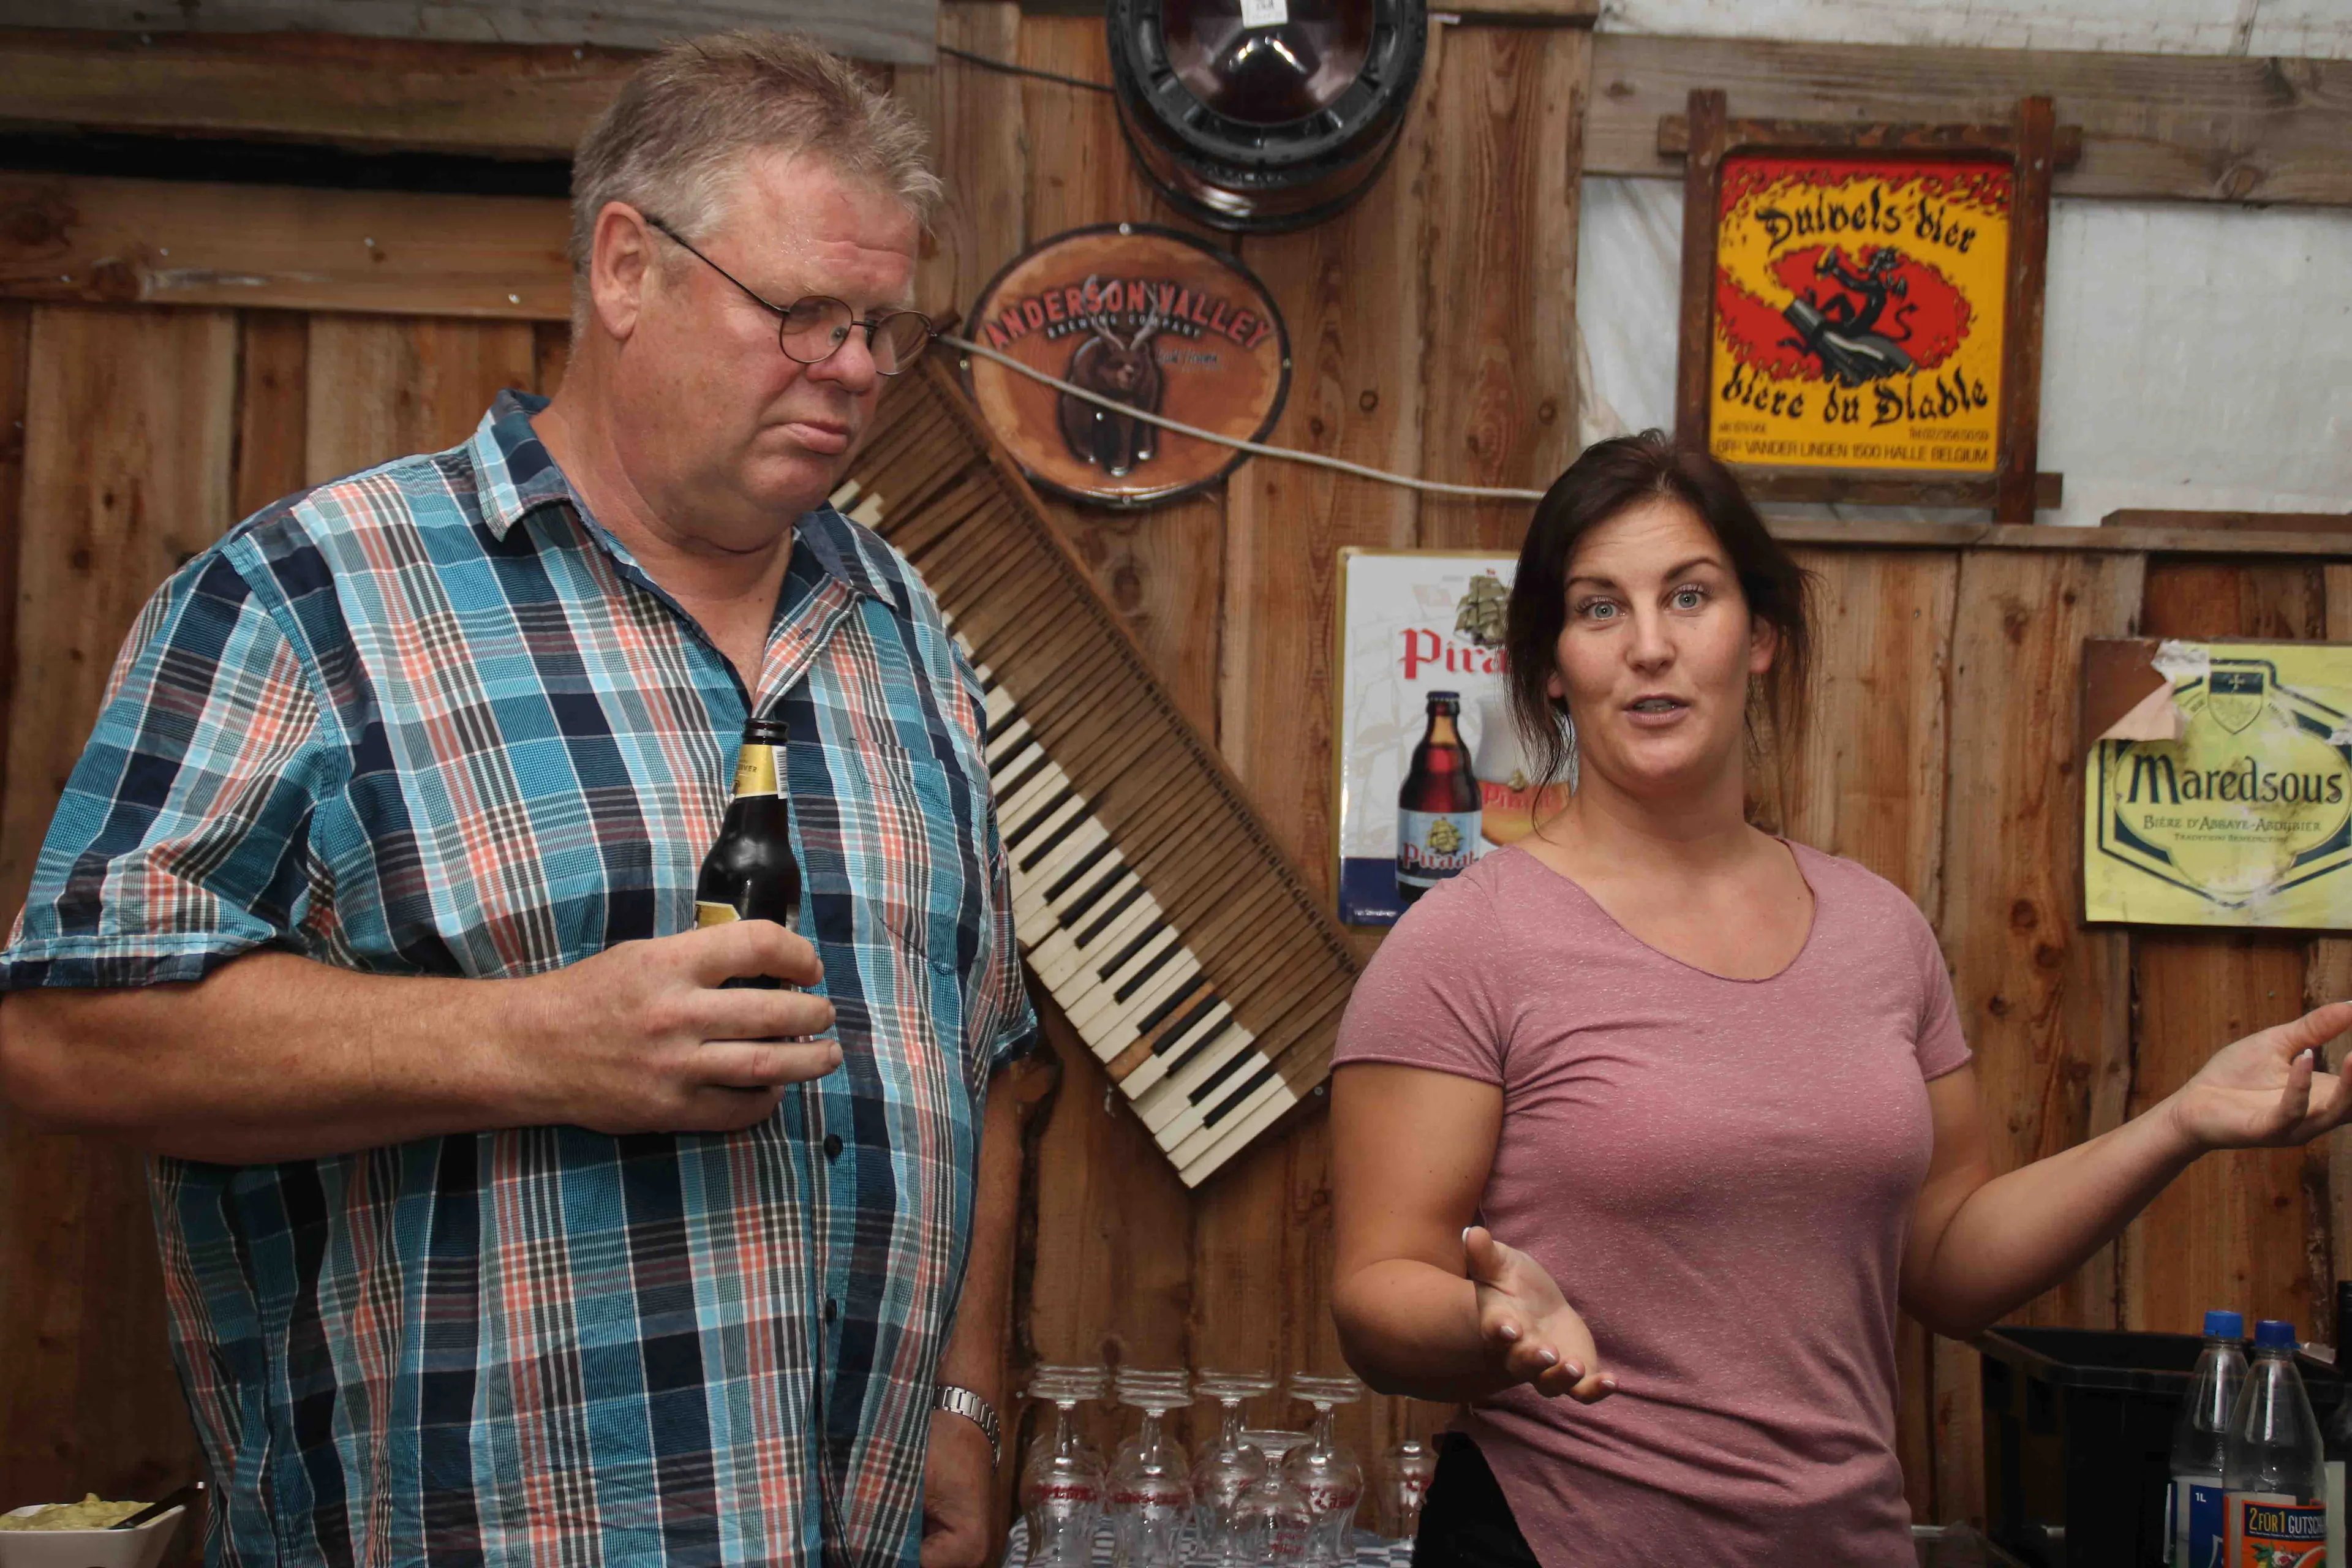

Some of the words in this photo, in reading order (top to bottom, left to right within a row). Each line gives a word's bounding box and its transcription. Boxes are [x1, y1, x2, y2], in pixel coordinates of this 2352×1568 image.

[1755, 184, 1900, 257] Duivels
[984, 281, 1144, 350] ANDERSON
[1159, 282, 1271, 349] VALLEY
[1823, 385, 1859, 423] du
[1871, 364, 1988, 428] Diable
[1884, 445, 1926, 460] HALLE
[1931, 446, 1989, 464] BELGIUM
[1398, 628, 1508, 679] Pira
[2127, 755, 2343, 805] Maredsous
[2195, 1493, 2207, 1502] 1L
[2249, 1507, 2258, 1531] 2
[2278, 1510, 2286, 1533] 1
